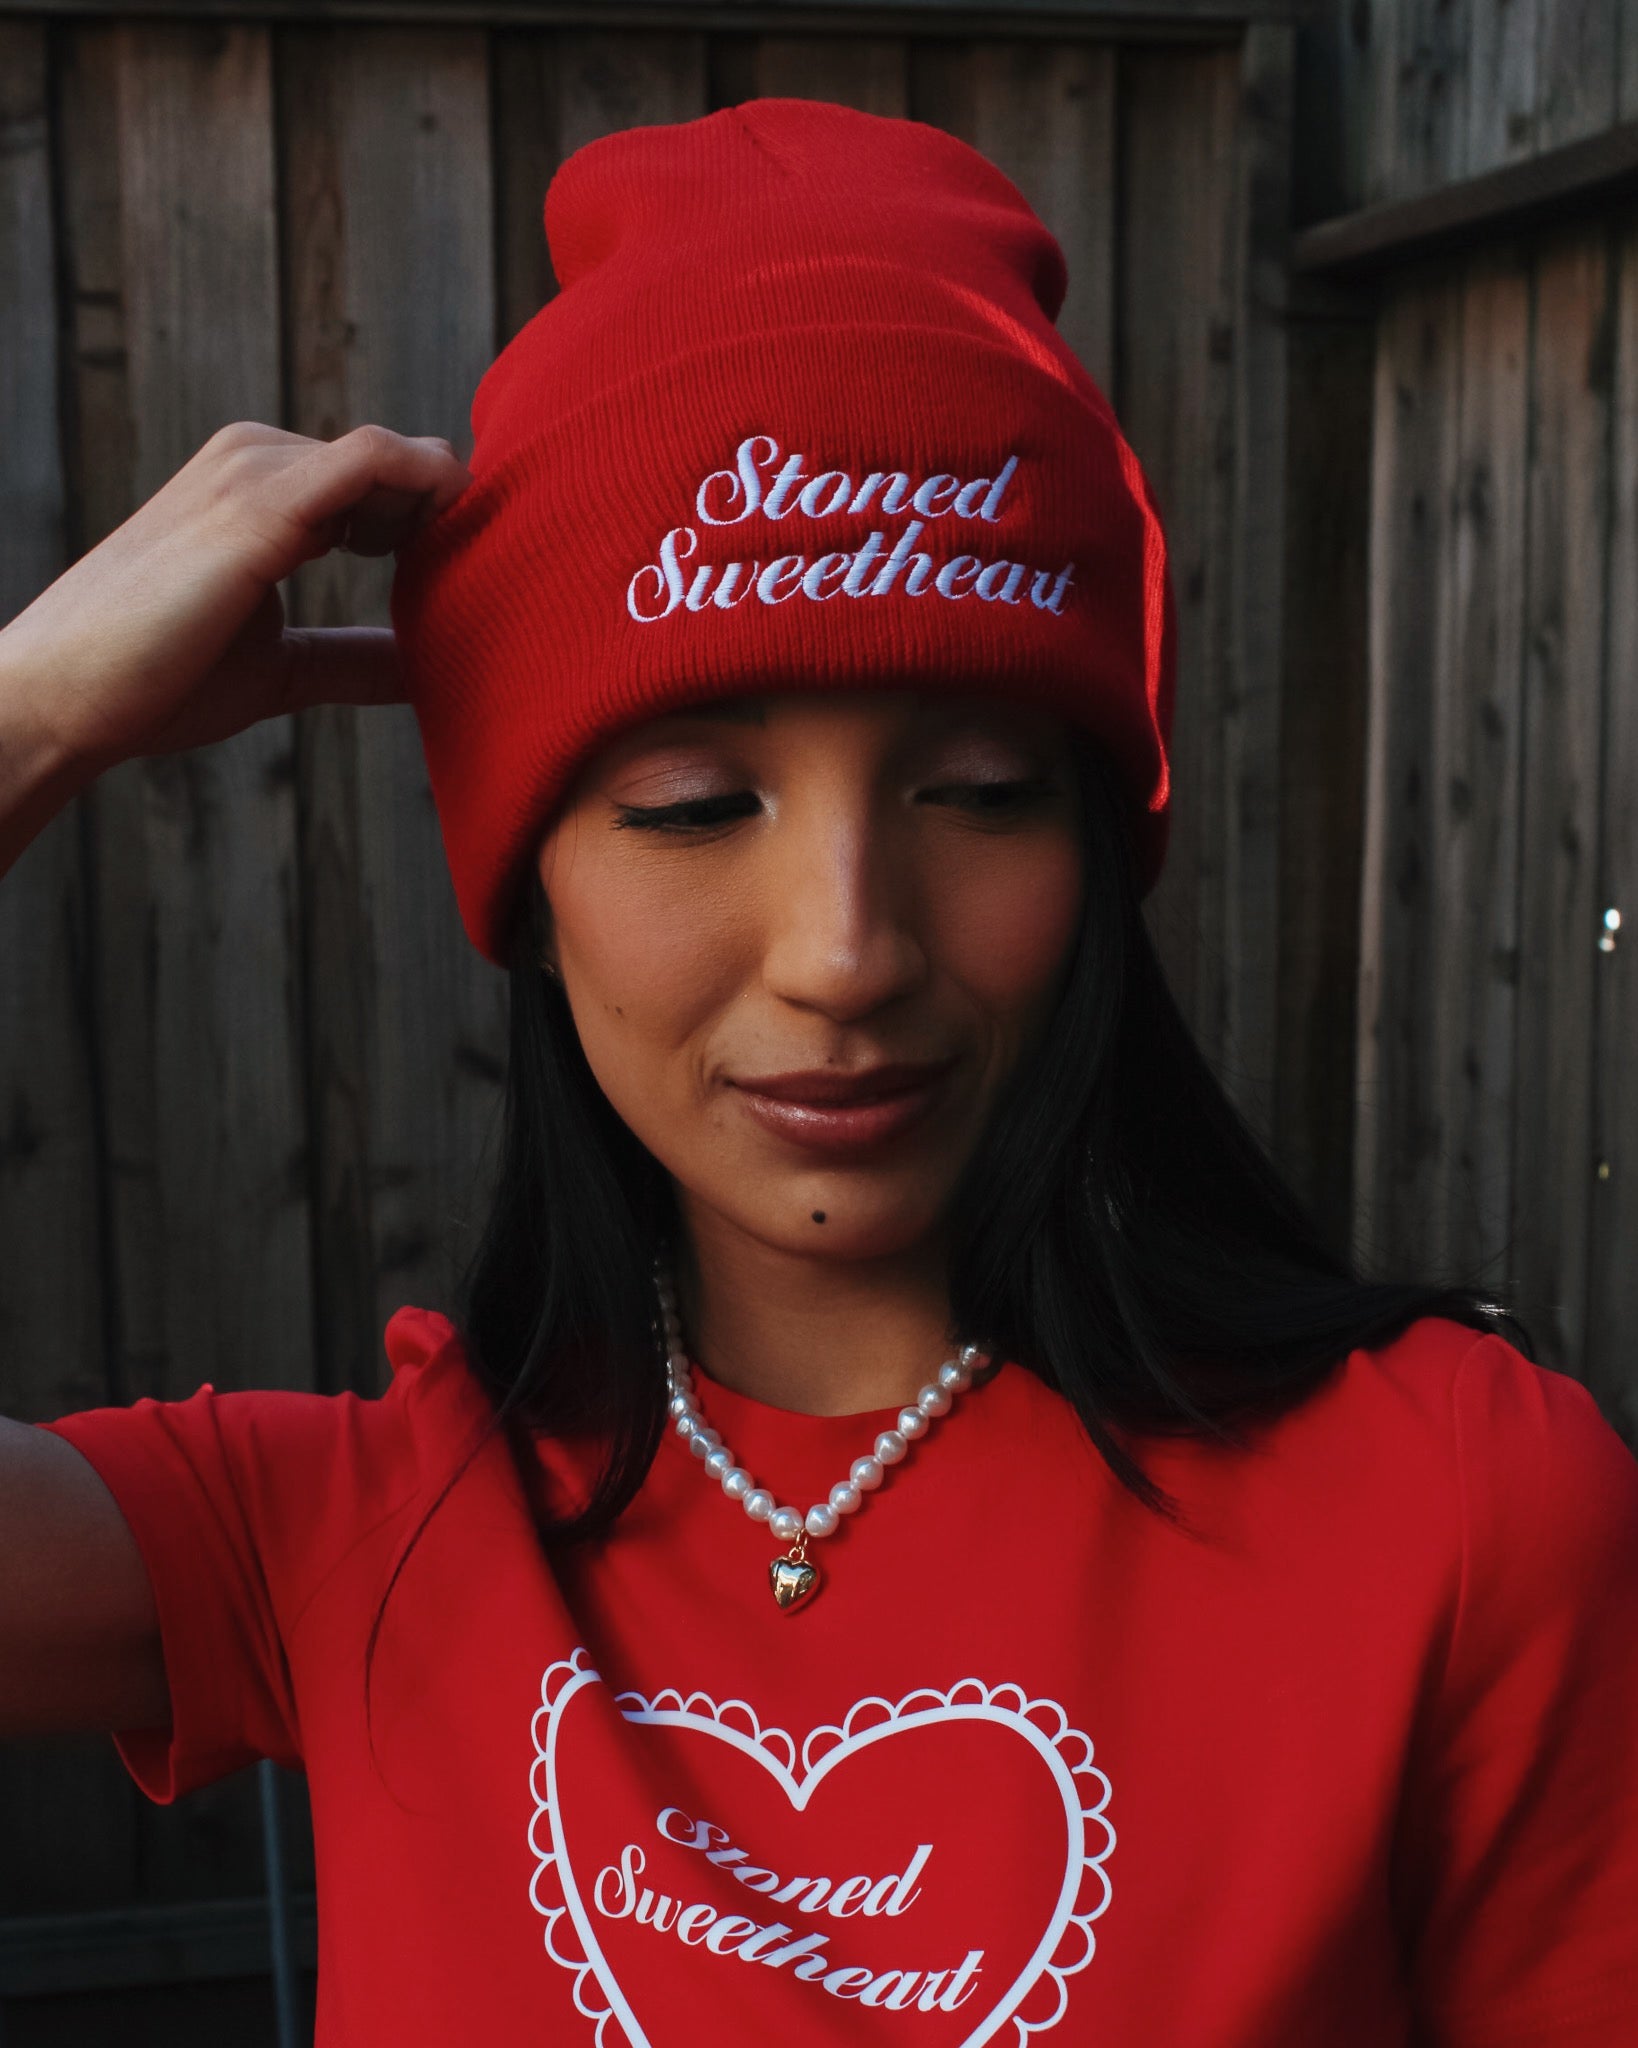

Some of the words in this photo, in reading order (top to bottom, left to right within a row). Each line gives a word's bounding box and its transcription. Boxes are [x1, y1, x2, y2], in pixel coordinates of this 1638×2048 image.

[696, 435, 1019, 525] Stoned
[627, 520, 1075, 623] Sweetheart
[656, 1807, 934, 1918] Stoned
[594, 1844, 985, 2012] Sweetheart
